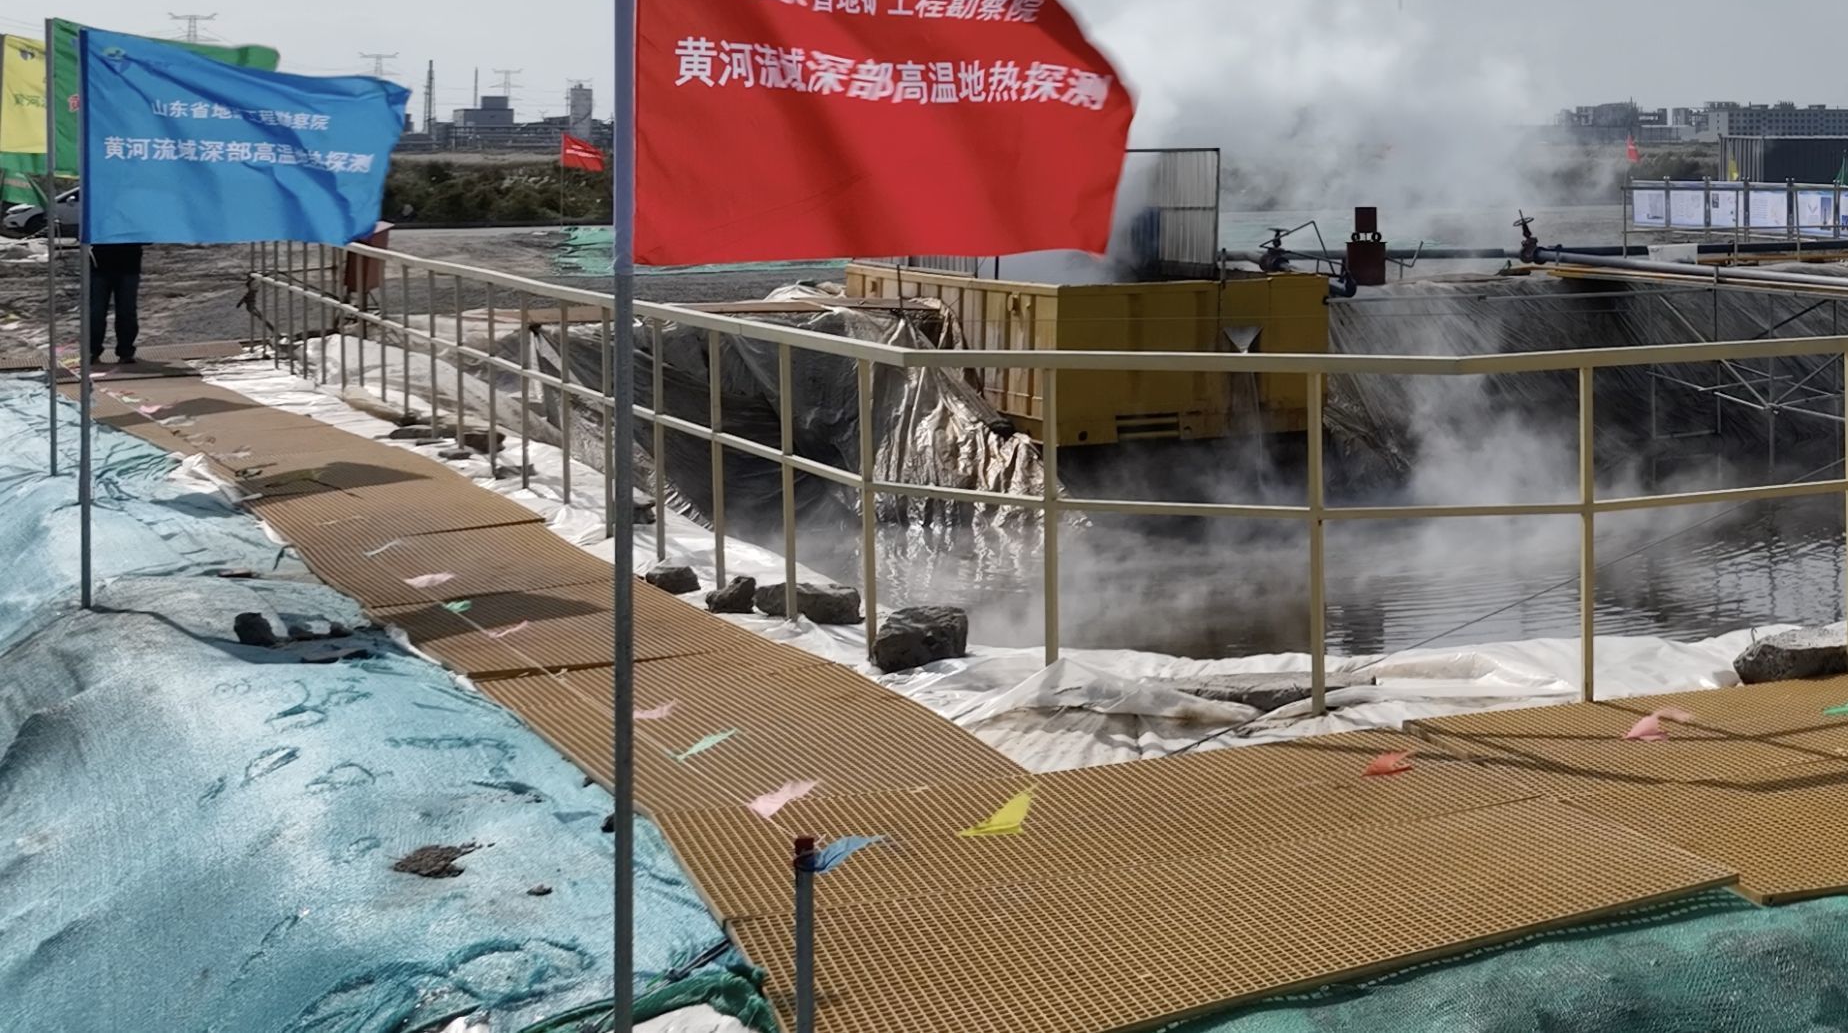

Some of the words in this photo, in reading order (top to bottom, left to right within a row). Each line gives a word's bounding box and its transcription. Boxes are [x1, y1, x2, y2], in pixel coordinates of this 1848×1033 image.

[674, 35, 1111, 111] 黄河流域深部高温地热探测
[151, 99, 332, 131] 山东省地工程勘察院
